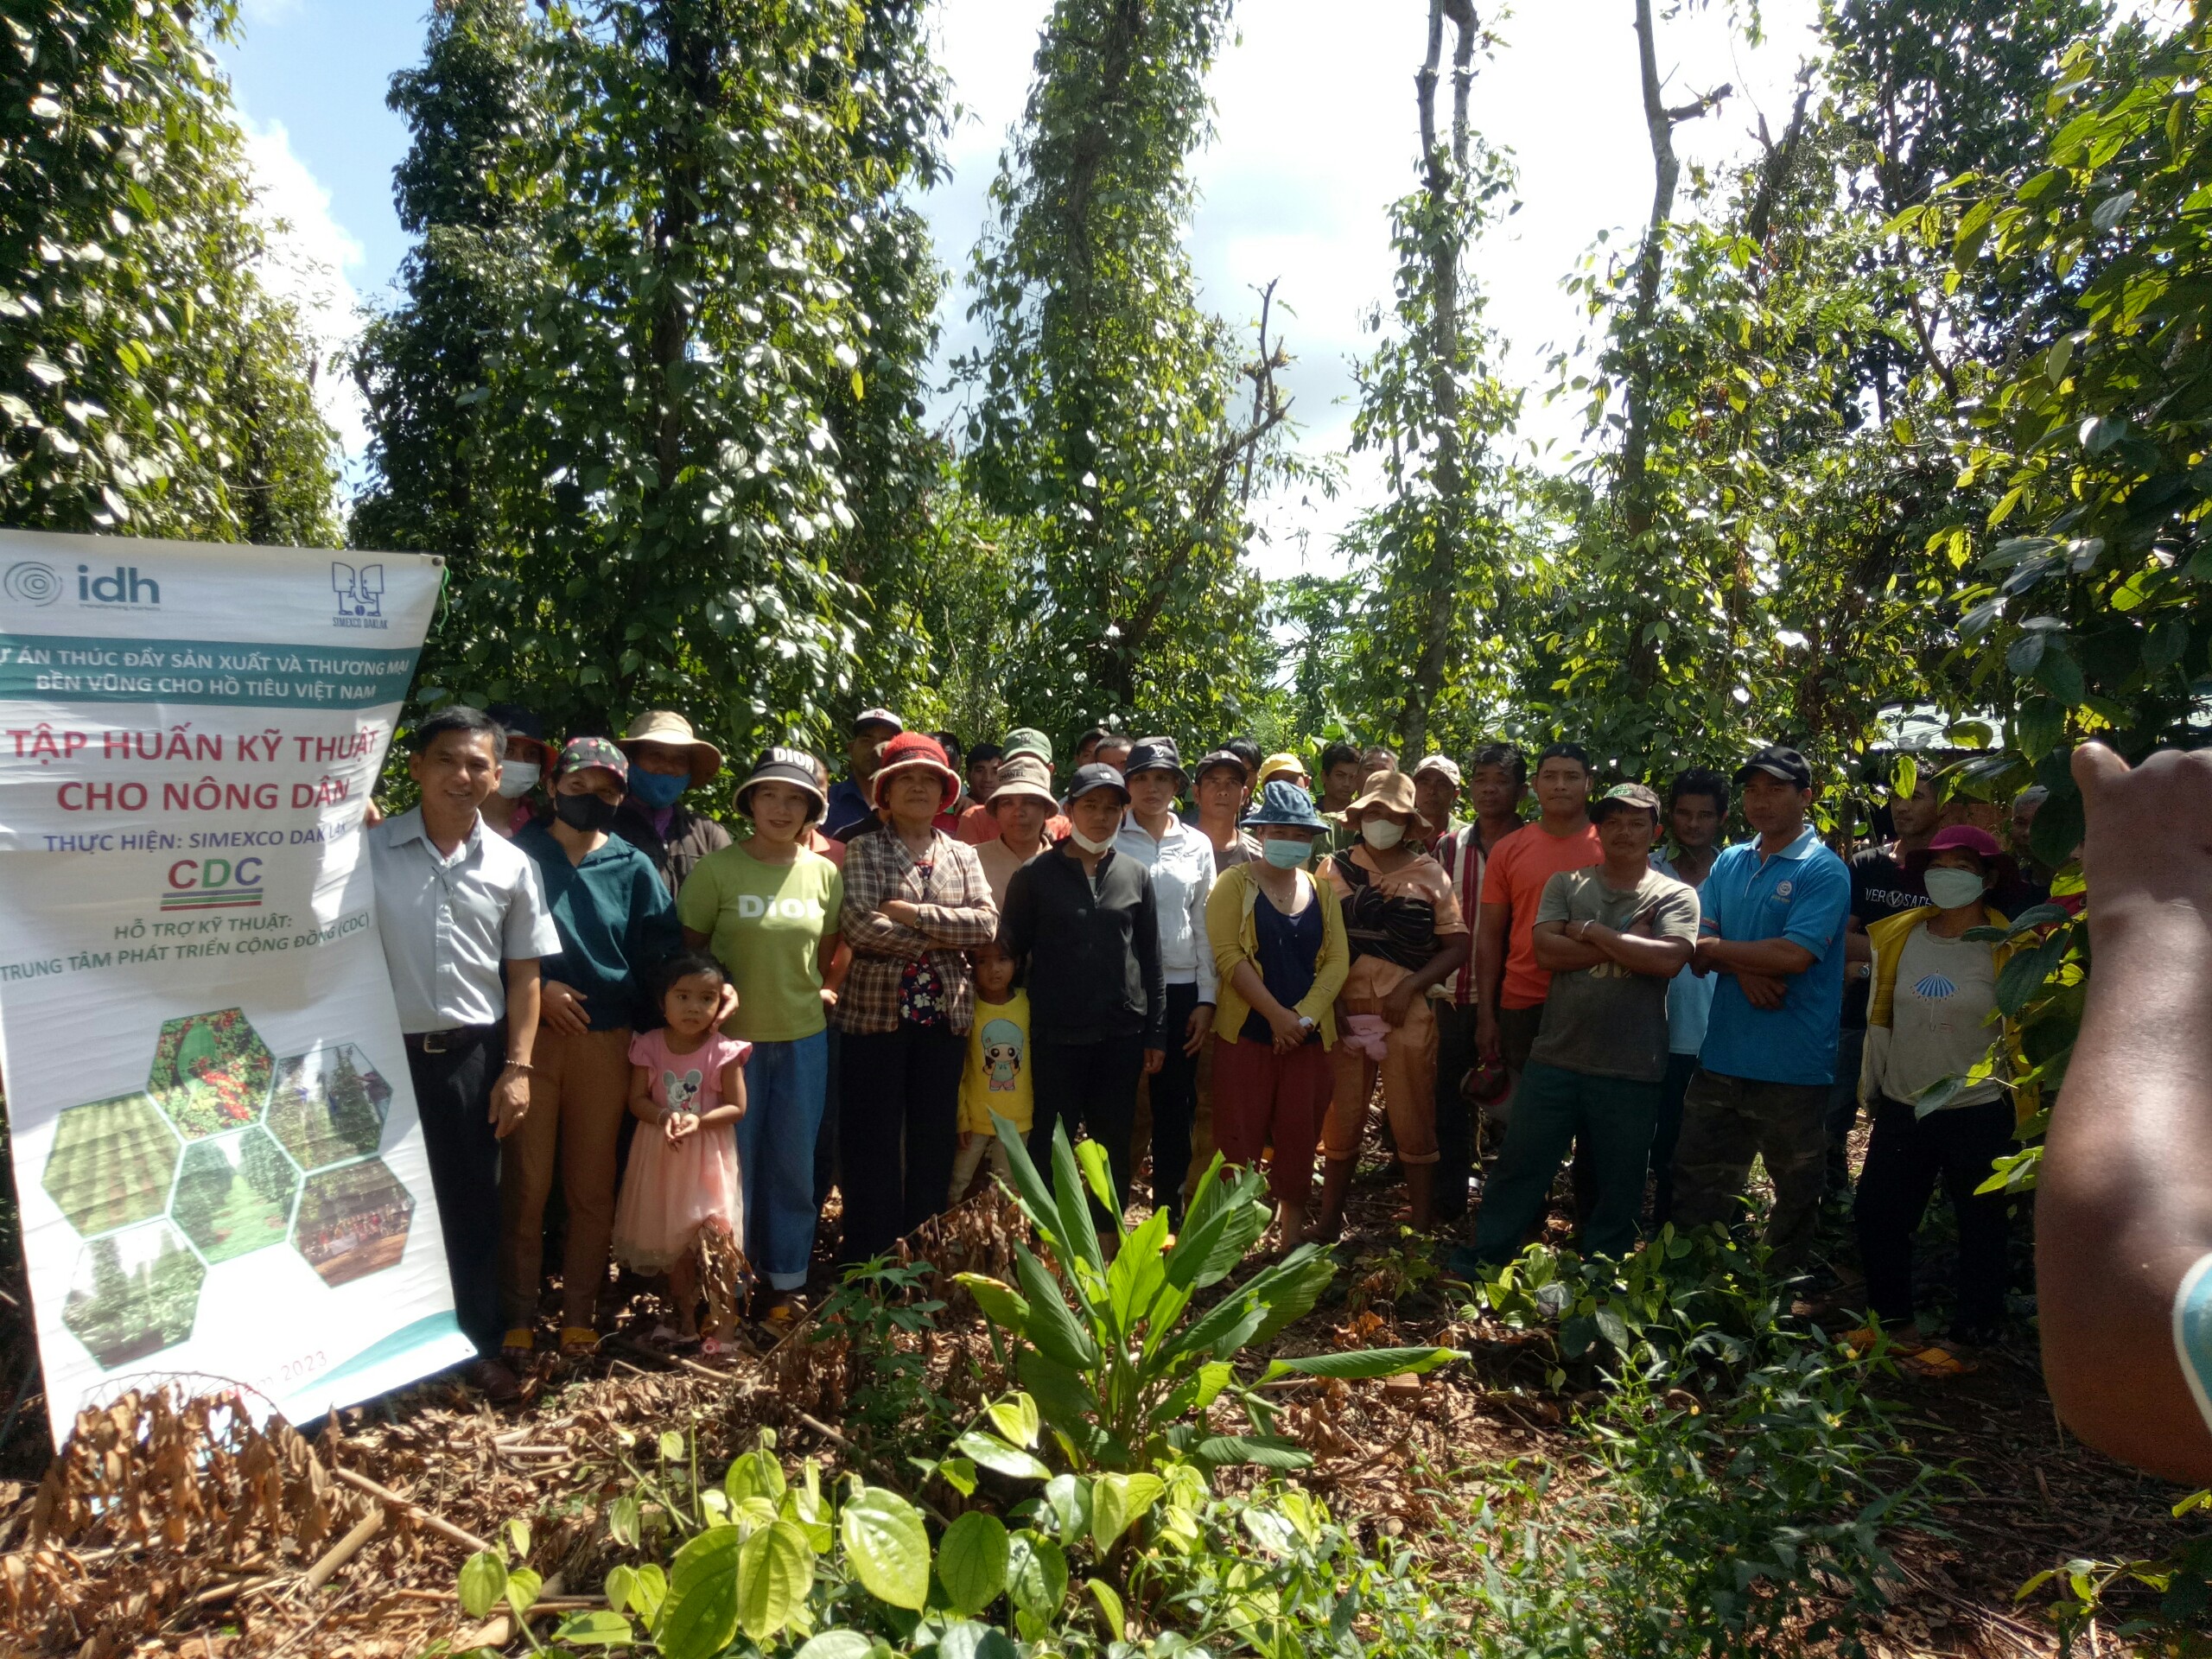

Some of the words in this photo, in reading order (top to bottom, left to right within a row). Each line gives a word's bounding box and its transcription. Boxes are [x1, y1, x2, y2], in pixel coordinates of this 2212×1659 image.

[78, 564, 160, 603] idh
[17, 645, 50, 664] ÁN
[57, 647, 118, 666] THÚC
[171, 649, 213, 669] SẢN
[219, 652, 270, 671] XUẤT
[276, 654, 302, 672] VÀ
[307, 658, 385, 676] THƯƠNG
[36, 670, 80, 690] BỀN
[87, 673, 151, 691] VŨNG
[158, 677, 202, 694] CHO
[210, 674, 239, 695] HỒ
[245, 678, 289, 696] TIÊU
[296, 680, 334, 701] VIỆT
[340, 685, 377, 699] NAM
[6, 722, 87, 766] TẬP
[103, 721, 222, 760] HUẤN
[238, 728, 283, 762] KỸ
[293, 726, 379, 762] THUẬT
[773, 747, 815, 774] DIOR
[57, 782, 148, 811] CHO
[163, 775, 279, 810] NÔNG
[291, 775, 350, 809] DÂN
[43, 833, 113, 855] THỰC
[121, 830, 182, 854] HIỆN:
[188, 830, 283, 849] SIMEXCO
[289, 827, 325, 845] DAK
[168, 857, 263, 889] CDC
[114, 918, 146, 940] HỖ
[152, 921, 195, 938] TRỢ
[198, 916, 221, 934] KỸ
[228, 912, 293, 932] THUẬT:
[0, 958, 62, 982] TRUNG
[67, 951, 111, 971] TÂM
[118, 944, 169, 965] PHÁT
[175, 938, 230, 960] TRIỂN
[236, 937, 289, 956] CỘNG
[294, 928, 335, 948] ĐỒNG
[338, 912, 370, 938] (CDC)
[280, 1351, 327, 1382] 2023
